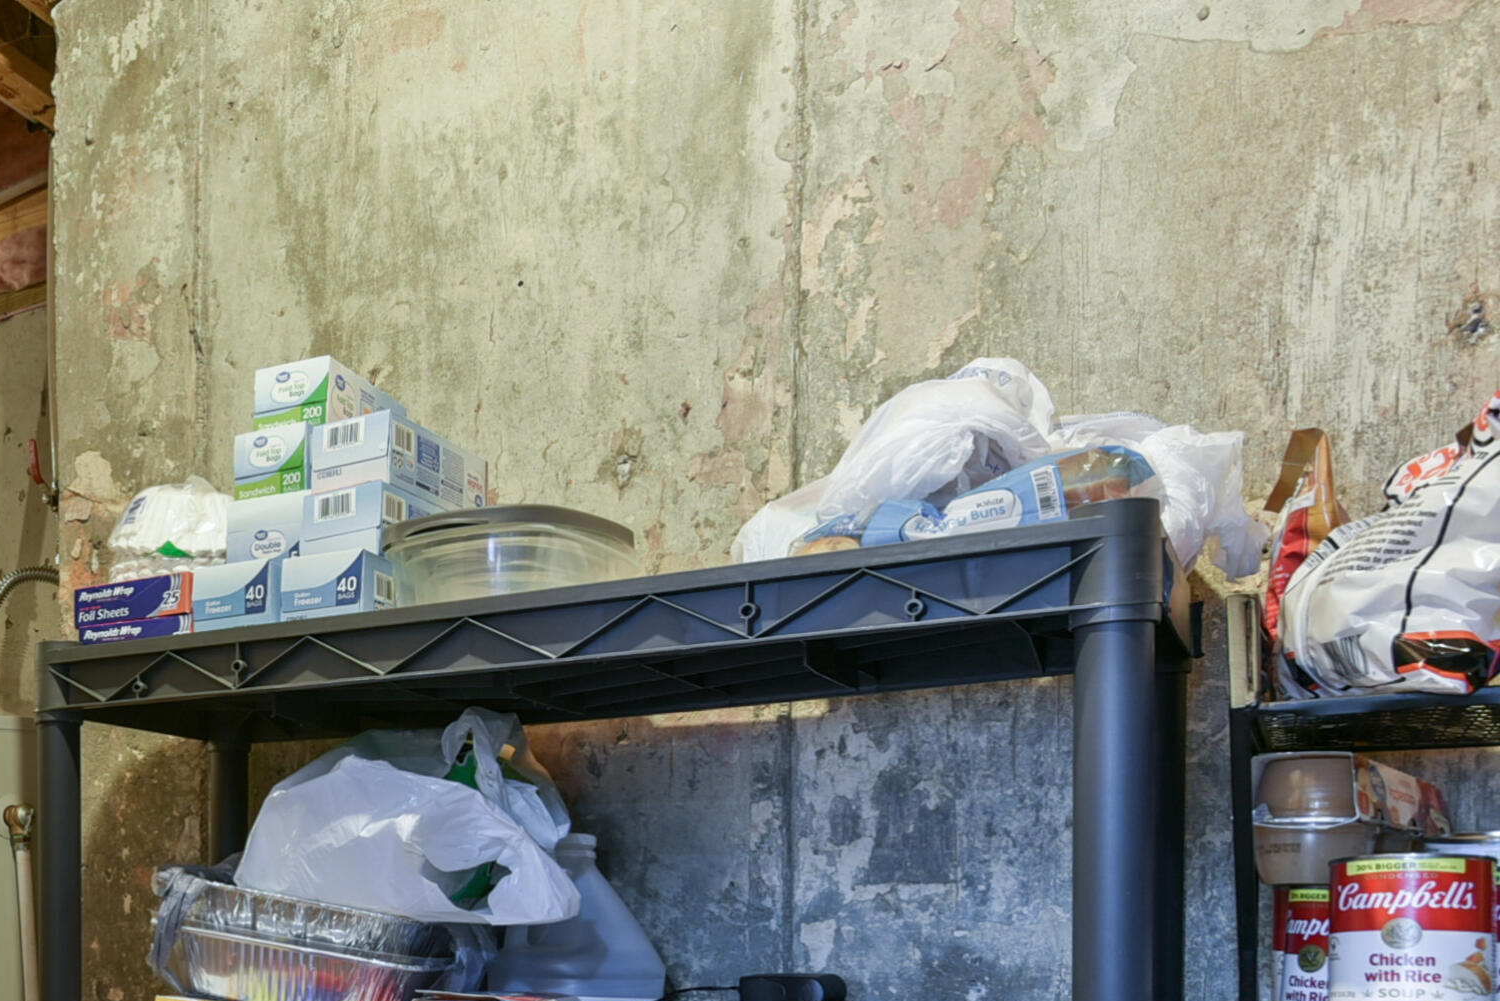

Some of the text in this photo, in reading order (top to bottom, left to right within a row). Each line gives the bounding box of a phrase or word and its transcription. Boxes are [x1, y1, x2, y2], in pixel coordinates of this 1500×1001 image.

[302, 406, 322, 420] 200
[283, 472, 301, 485] 200
[239, 485, 276, 499] Sandwich
[970, 505, 1006, 521] Buns
[337, 575, 357, 593] 40
[79, 586, 134, 602] Reynolds Wrap
[163, 591, 180, 605] 25
[246, 584, 264, 600] 40
[338, 591, 356, 600] BAGS
[294, 596, 322, 606] Freezer
[78, 606, 129, 623] Foil Sheets
[205, 604, 232, 615] Freezer
[84, 625, 142, 641] Reynolds Wrap
[1375, 862, 1418, 872] BIGGER
[1338, 880, 1476, 915] Campbell's
[1369, 953, 1436, 967] Chicken
[1365, 969, 1442, 983] with Rice
[1286, 991, 1307, 1001] with
[1378, 987, 1426, 1000] SOUP
